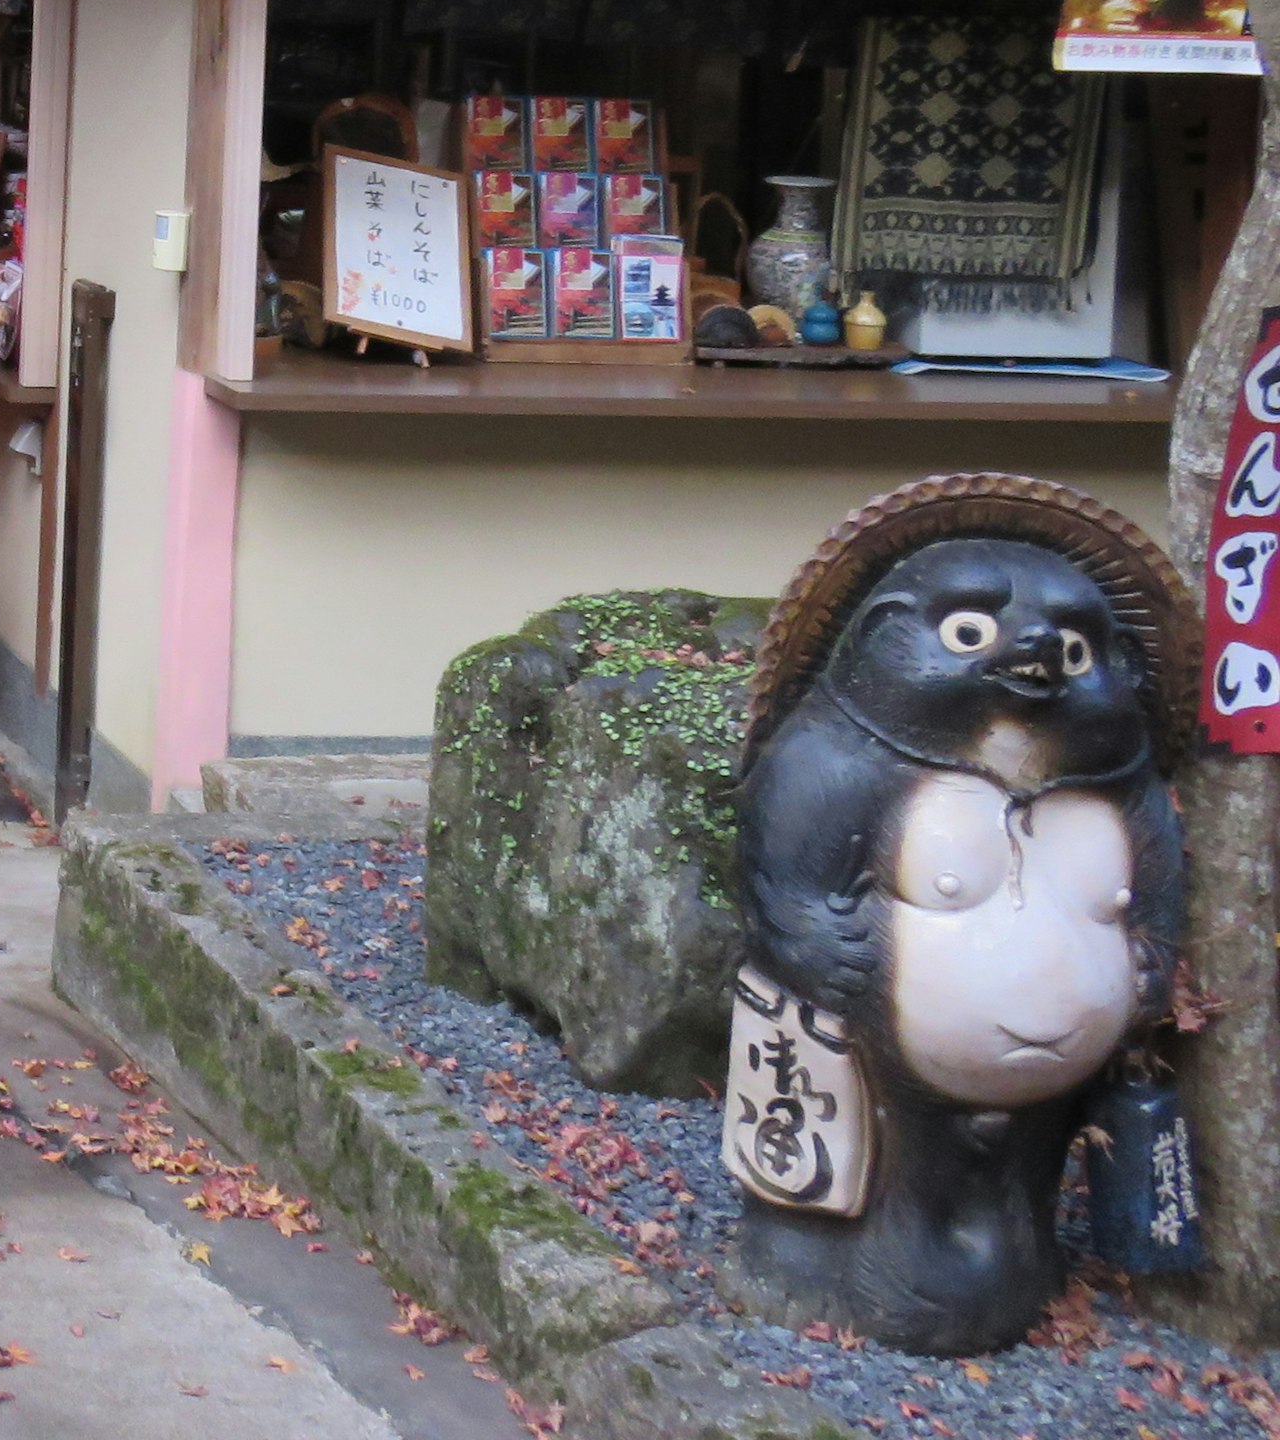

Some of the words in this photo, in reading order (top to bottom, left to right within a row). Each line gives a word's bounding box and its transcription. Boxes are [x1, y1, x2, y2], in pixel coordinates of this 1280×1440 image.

[410, 179, 439, 285] にしんそば
[371, 286, 428, 314] ¥1000
